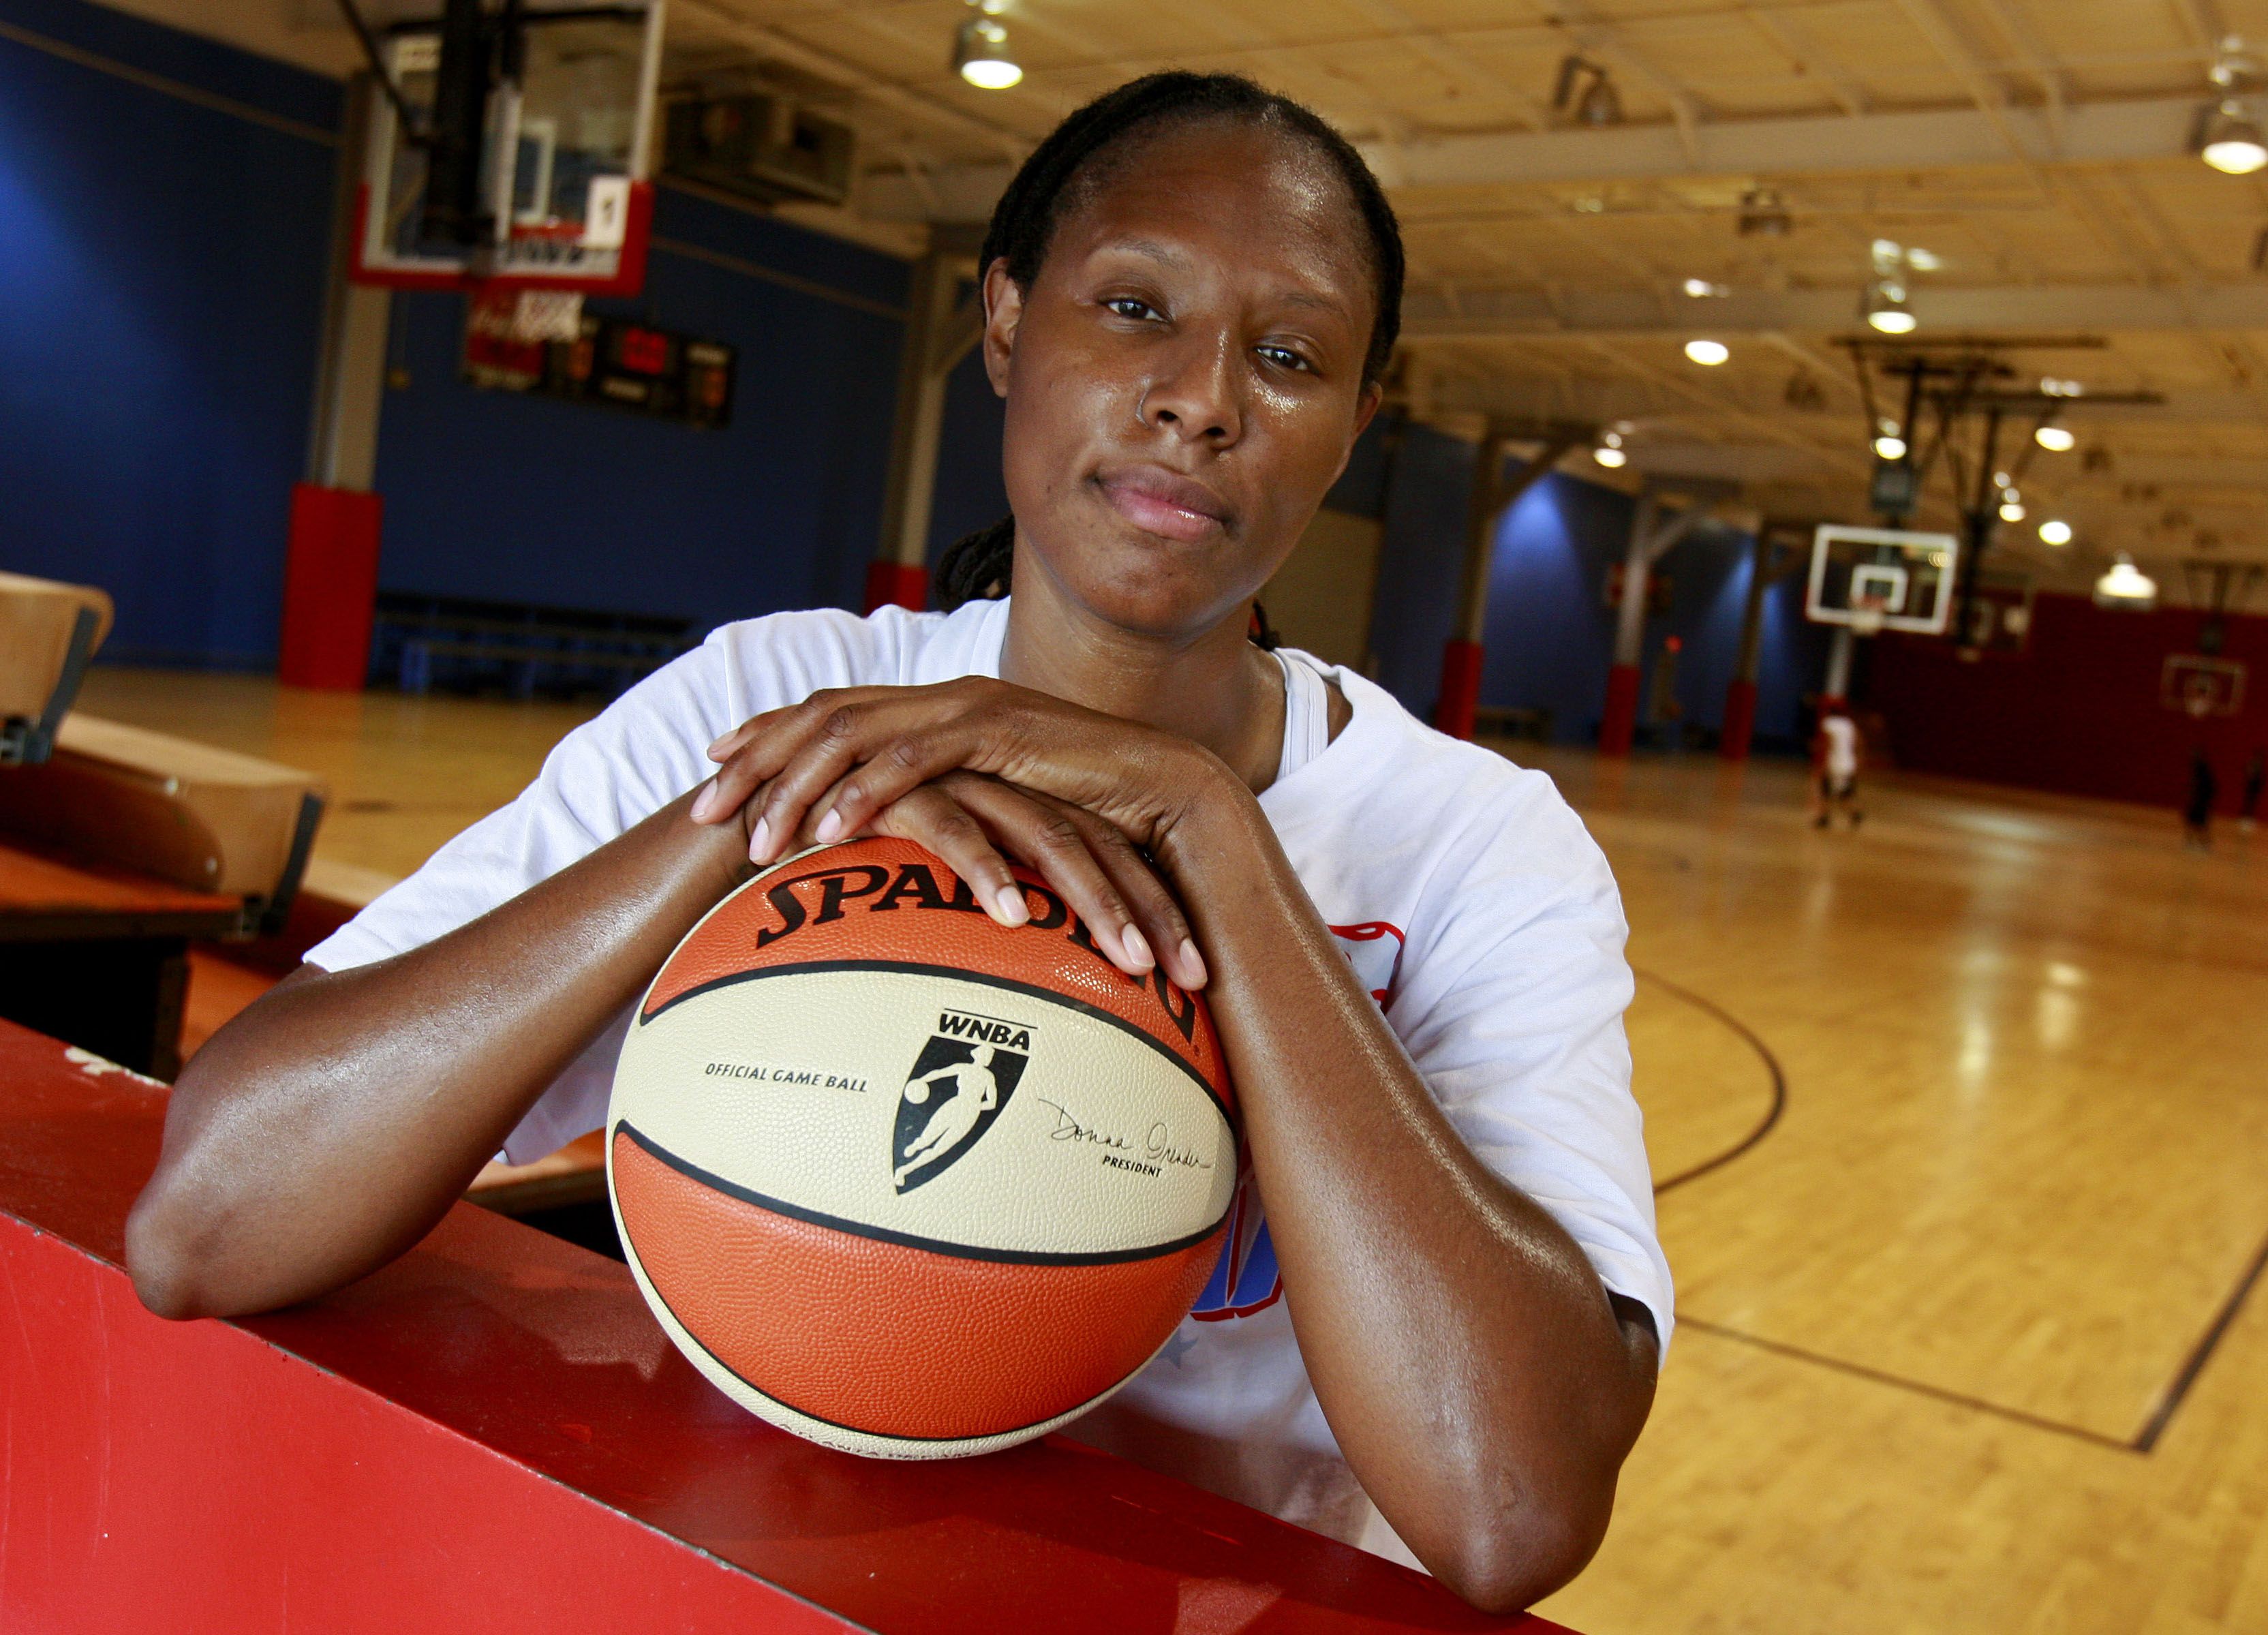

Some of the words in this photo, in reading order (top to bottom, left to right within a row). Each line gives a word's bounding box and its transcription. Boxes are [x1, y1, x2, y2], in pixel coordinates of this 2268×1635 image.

[939, 1013, 1030, 1051] WNBA
[705, 1063, 767, 1080] OFFICIAL
[772, 1069, 821, 1086] GAME
[825, 1075, 867, 1092] BALL
[1038, 1098, 1134, 1150] Donna
[1102, 1155, 1163, 1178] PRESIDENT
